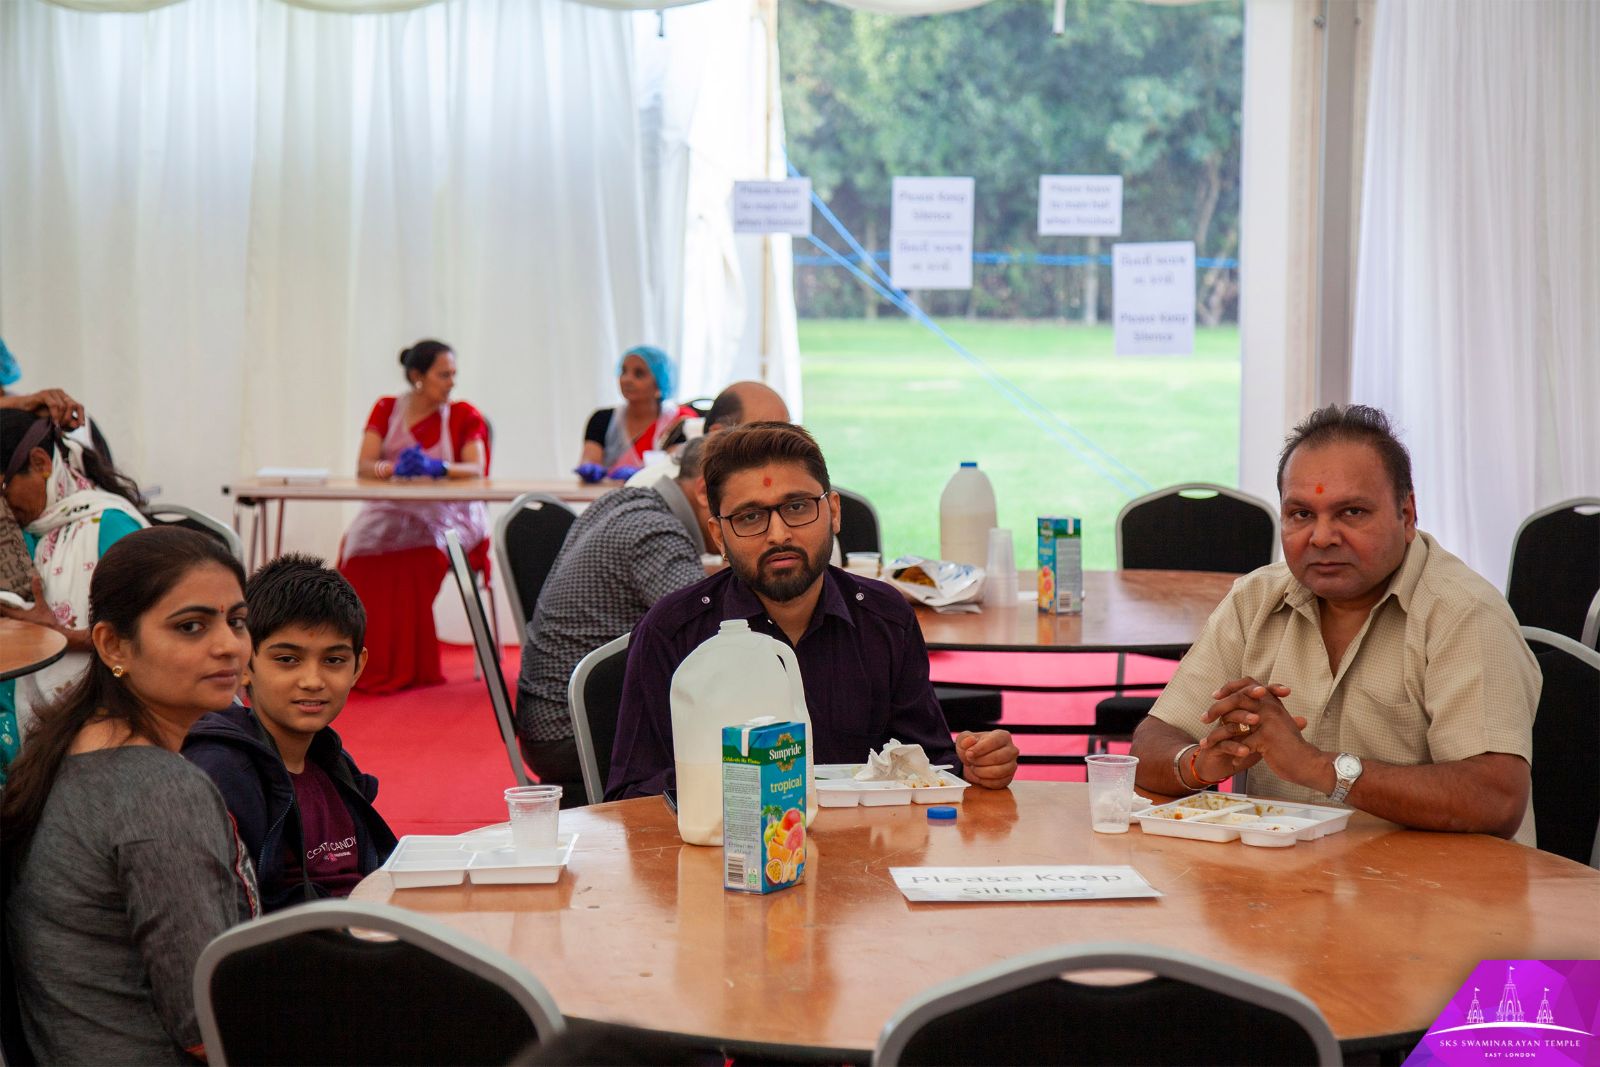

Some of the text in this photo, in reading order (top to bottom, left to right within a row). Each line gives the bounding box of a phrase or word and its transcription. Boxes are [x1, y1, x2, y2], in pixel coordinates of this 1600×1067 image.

[768, 743, 802, 761] Sunpride
[769, 773, 802, 793] tropical
[330, 836, 357, 851] CANDY
[911, 873, 1122, 885] Please Keep
[962, 886, 1088, 896] Silence
